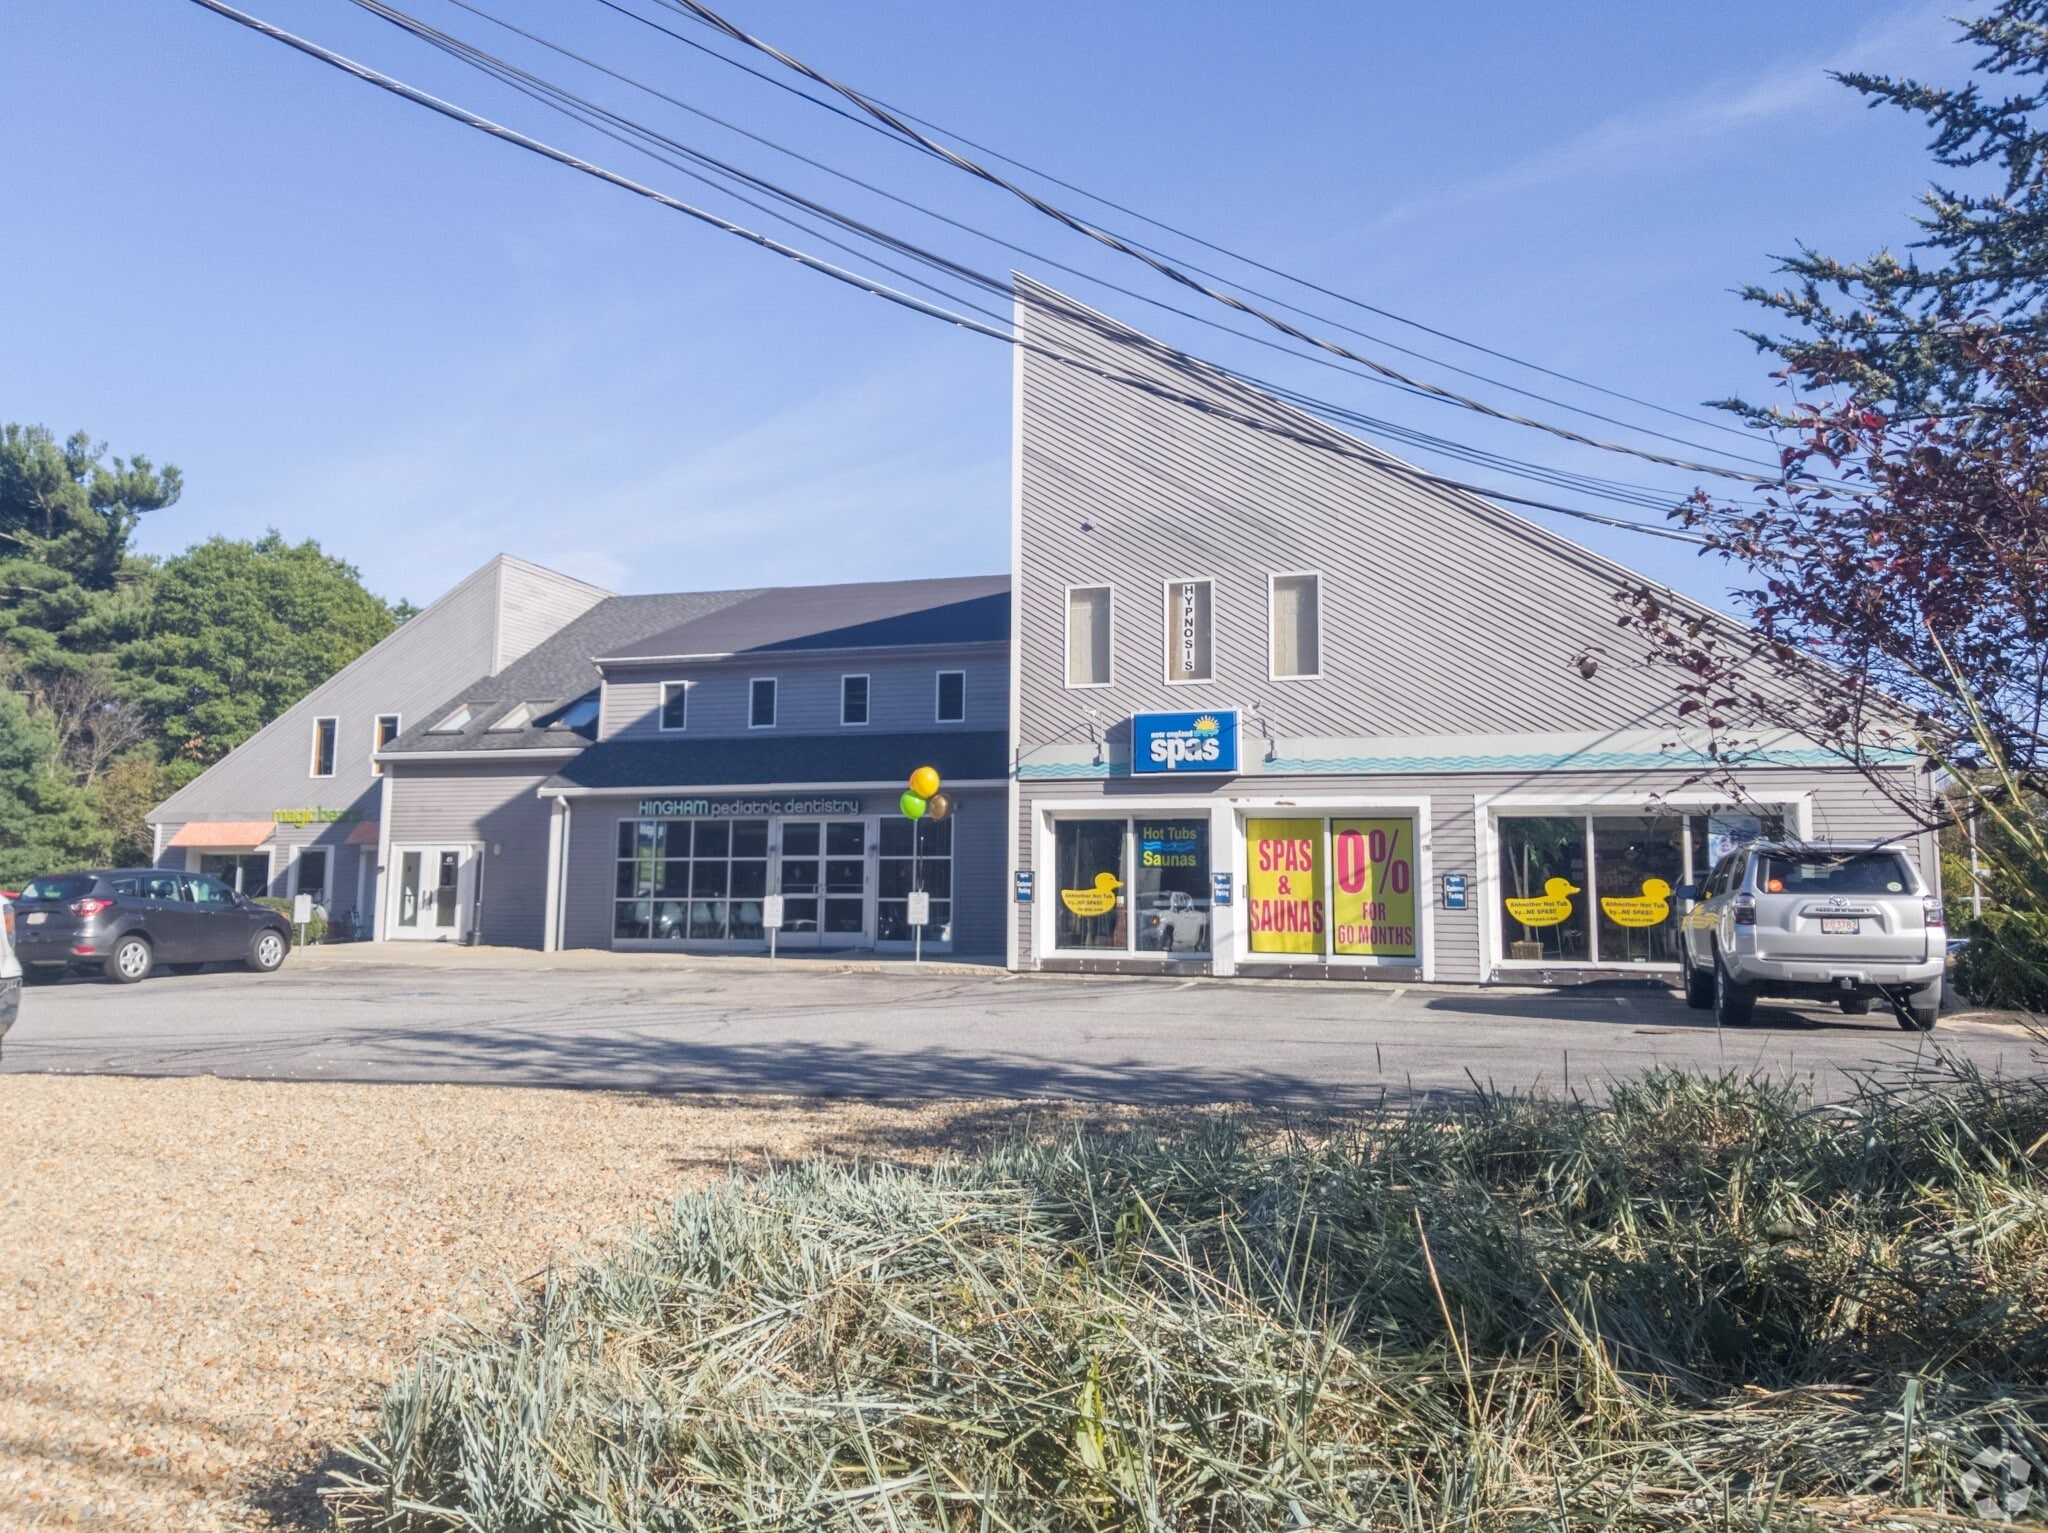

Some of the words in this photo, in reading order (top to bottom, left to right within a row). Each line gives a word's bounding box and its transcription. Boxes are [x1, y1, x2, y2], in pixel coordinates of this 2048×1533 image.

[1184, 585, 1194, 671] HYPNOSIS
[1150, 738, 1220, 769] spas
[639, 800, 709, 815] HINGHAM
[711, 799, 781, 818] pediatric
[784, 798, 859, 816] dentistry
[1143, 827, 1165, 840] Hot
[1167, 826, 1197, 840] Tubs
[1143, 850, 1197, 867] Saunas
[1258, 838, 1312, 872] SPAS
[1337, 828, 1410, 895] 0%
[1278, 875, 1291, 895] &
[1250, 899, 1324, 934] SAUNAS
[1362, 902, 1386, 921] FOR
[1338, 924, 1354, 944] 60
[1358, 925, 1413, 946] MONTHS
